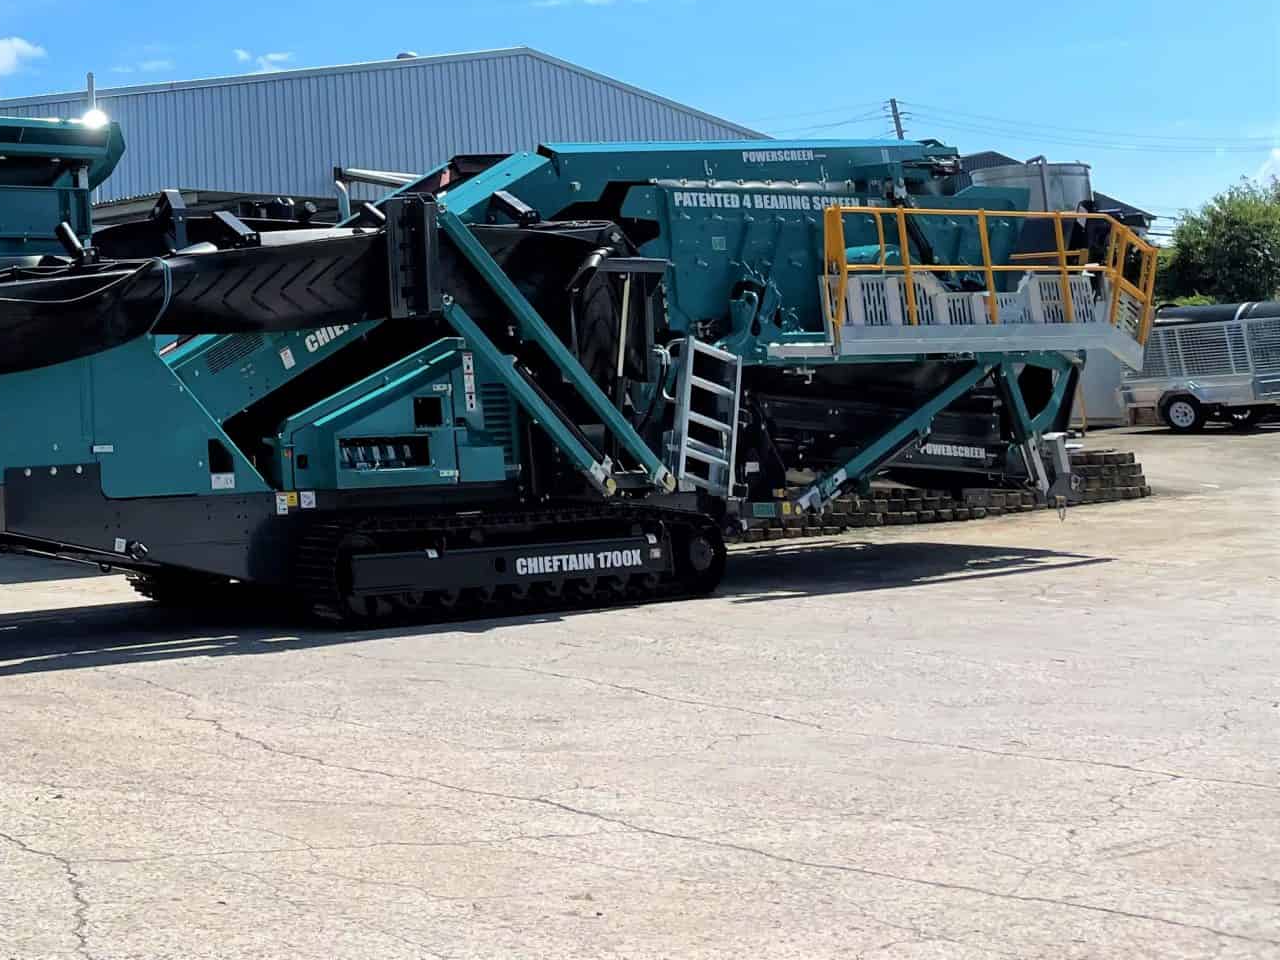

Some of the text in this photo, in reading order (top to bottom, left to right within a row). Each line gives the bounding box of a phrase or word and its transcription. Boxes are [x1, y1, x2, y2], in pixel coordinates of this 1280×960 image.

[742, 150, 814, 162] POWERSCREEN
[674, 191, 740, 208] PATENTED
[742, 194, 752, 209] 4
[753, 194, 810, 210] BEARING
[516, 549, 642, 575] CHIEFTAIN 1700X
